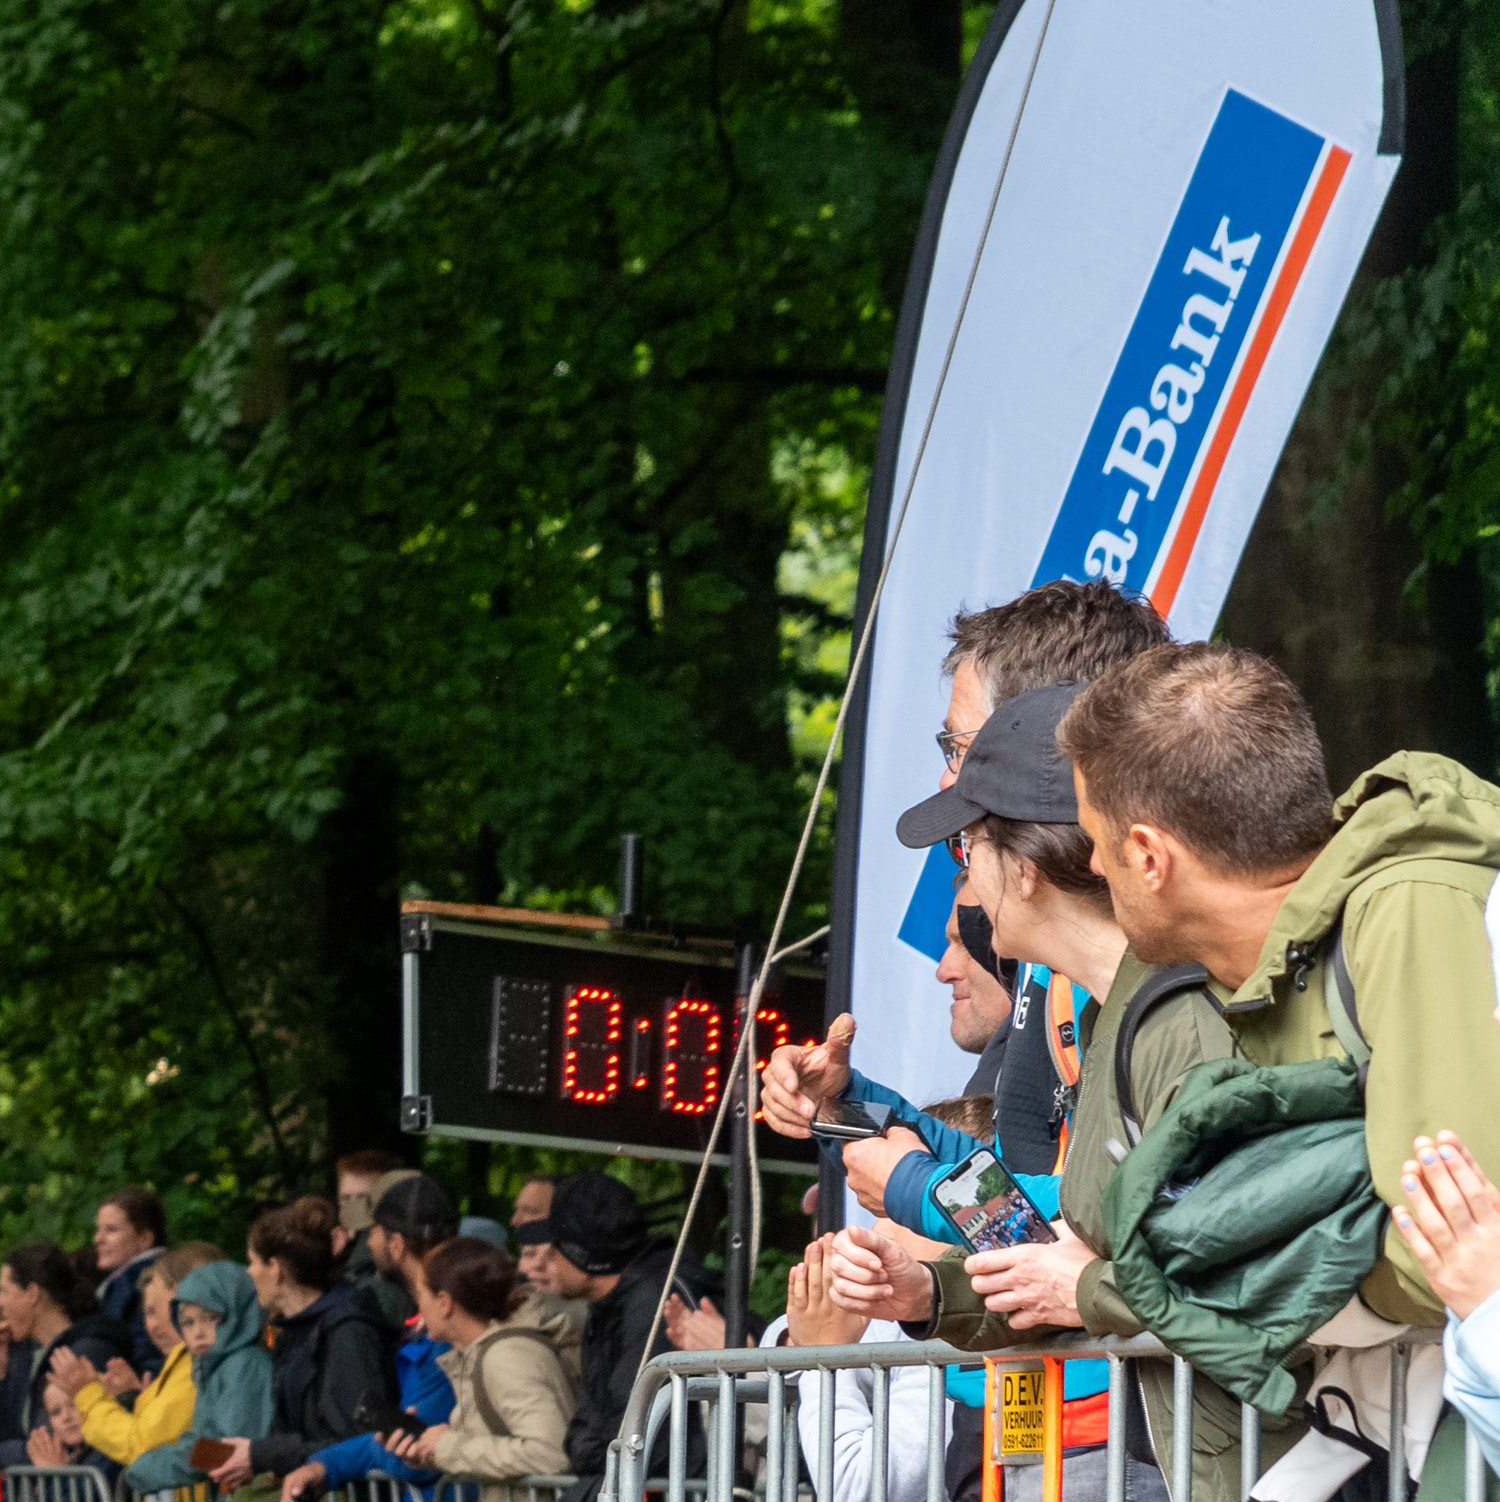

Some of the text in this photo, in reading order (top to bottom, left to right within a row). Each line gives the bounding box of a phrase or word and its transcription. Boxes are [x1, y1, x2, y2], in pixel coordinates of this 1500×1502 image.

[1084, 215, 1263, 587] a-Bank
[1004, 1374, 1043, 1406] D.E.V.
[1004, 1410, 1043, 1429] VERHUUR
